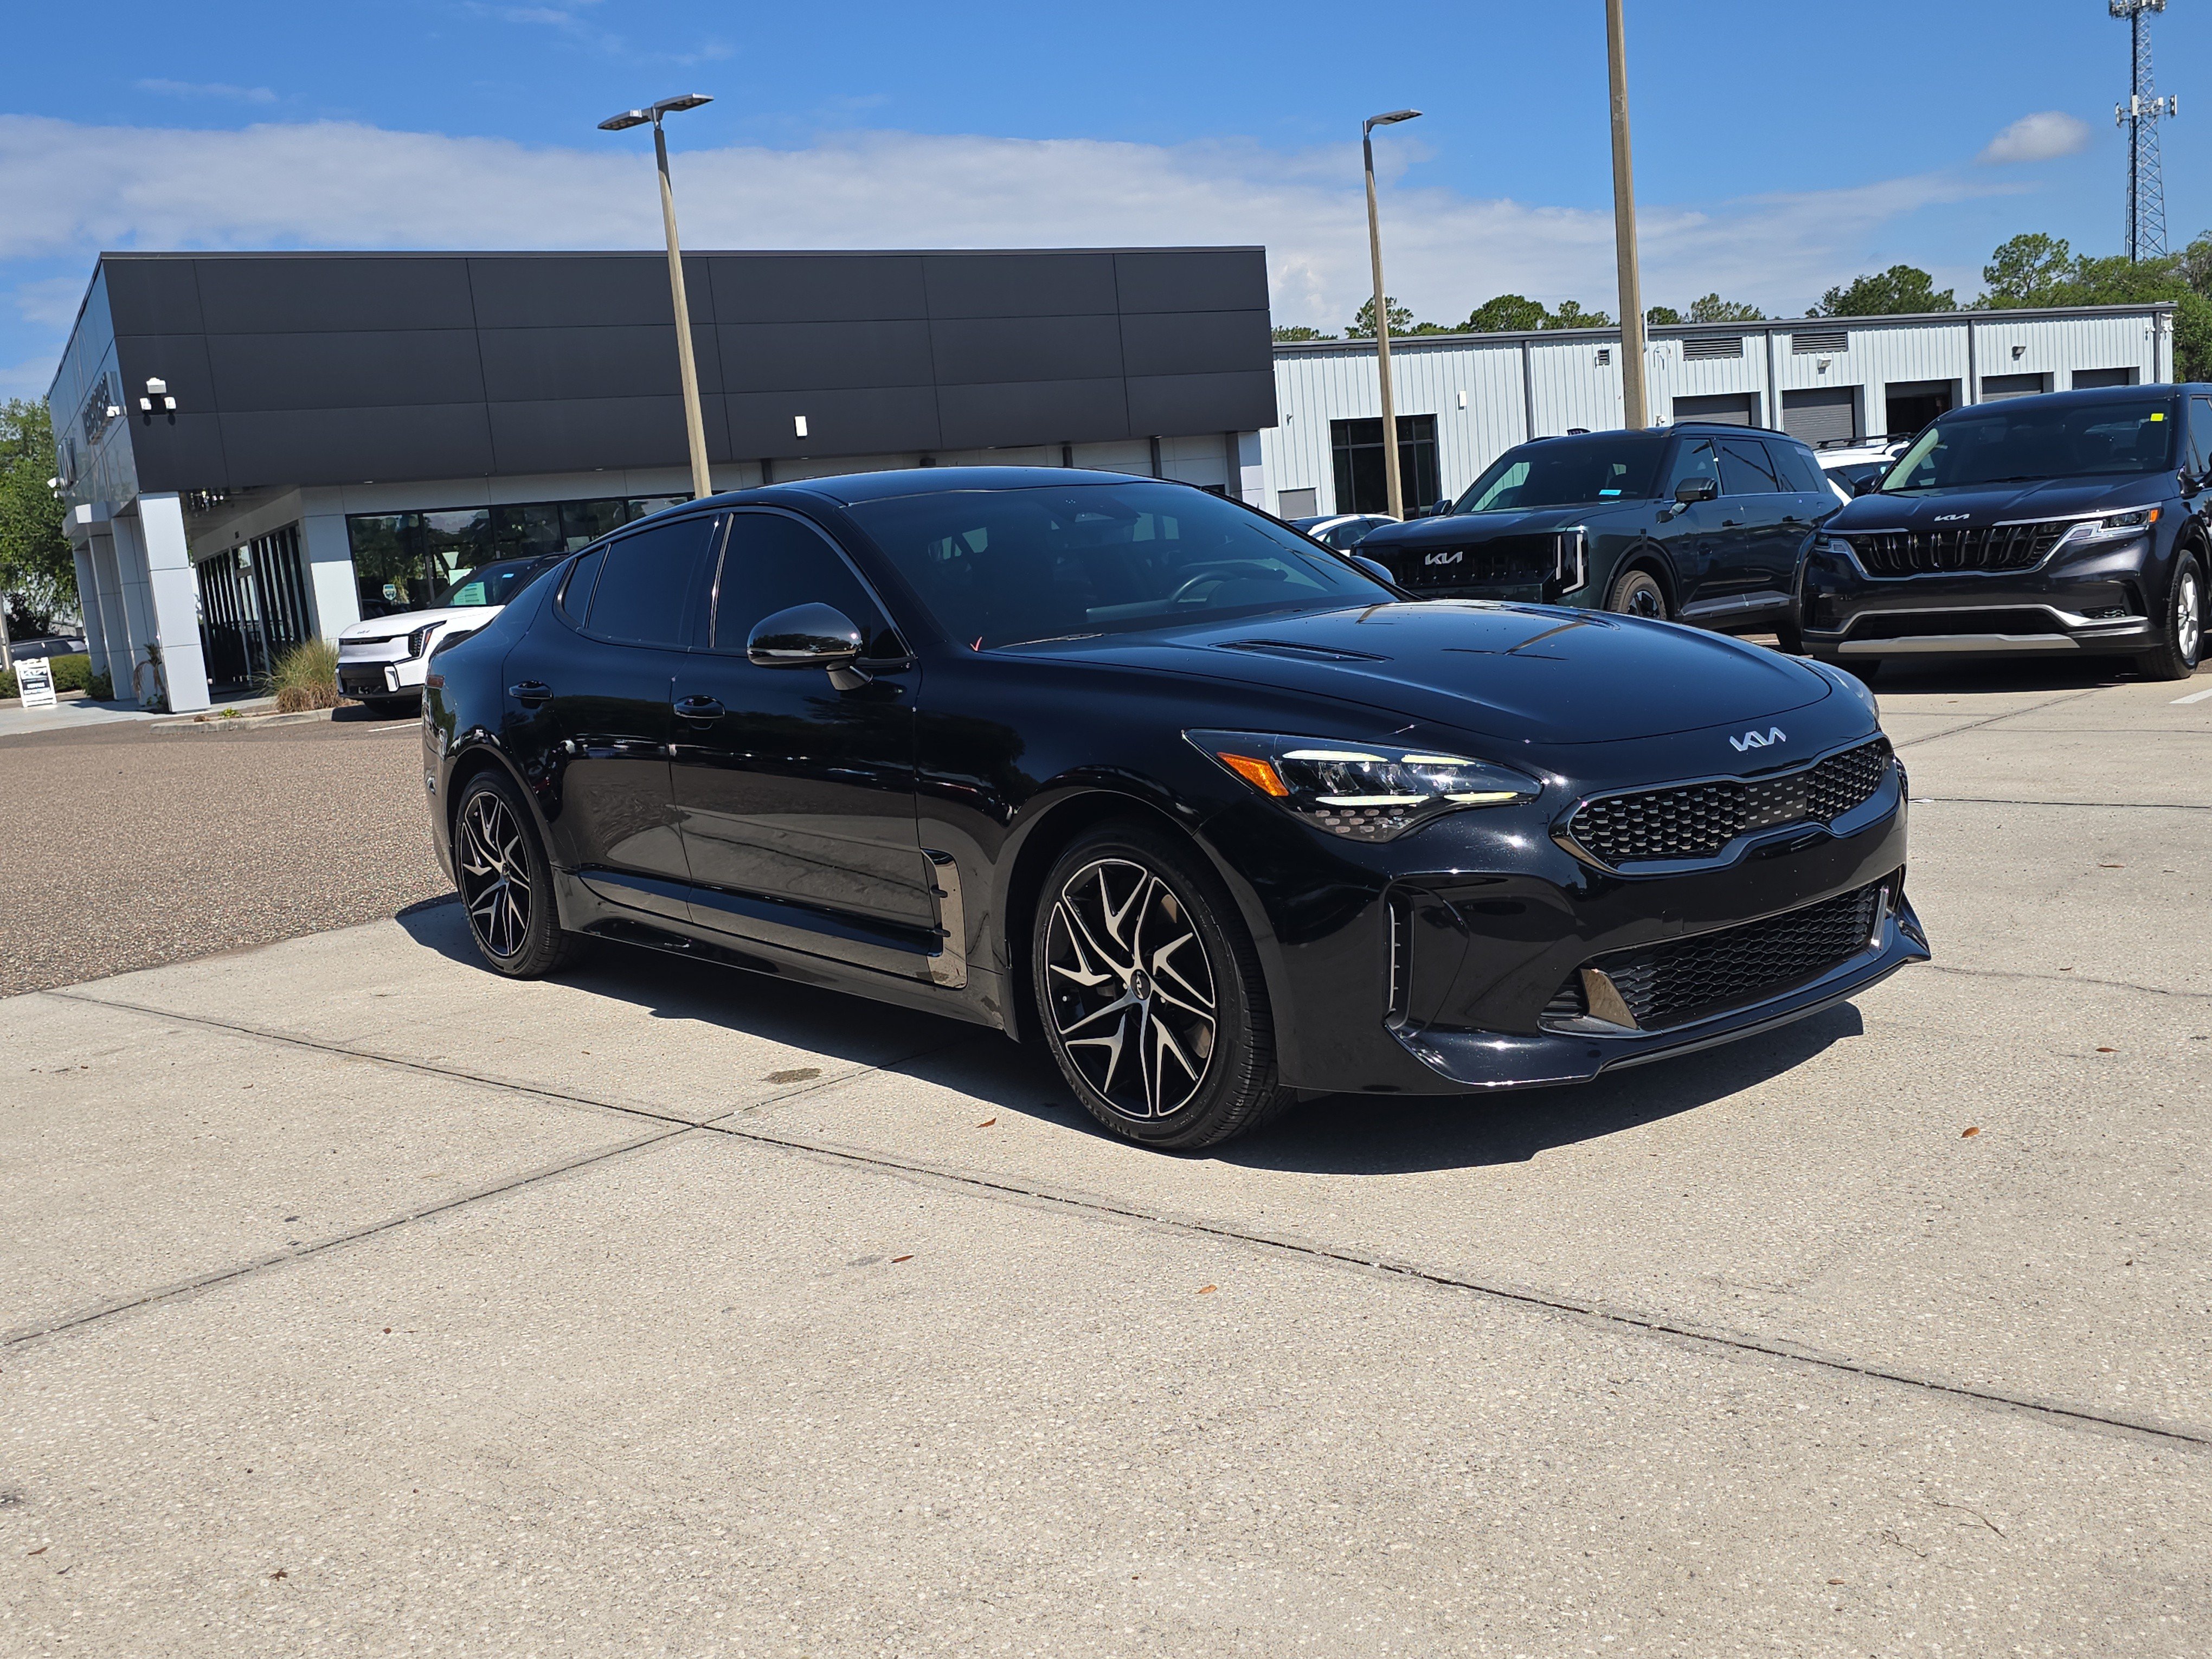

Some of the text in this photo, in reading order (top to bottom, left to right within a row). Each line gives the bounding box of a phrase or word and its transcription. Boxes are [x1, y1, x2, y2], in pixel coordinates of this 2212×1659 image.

[1934, 513, 1970, 522] KIA
[1425, 551, 1463, 565] KIA
[1729, 727, 1786, 751] KIA
